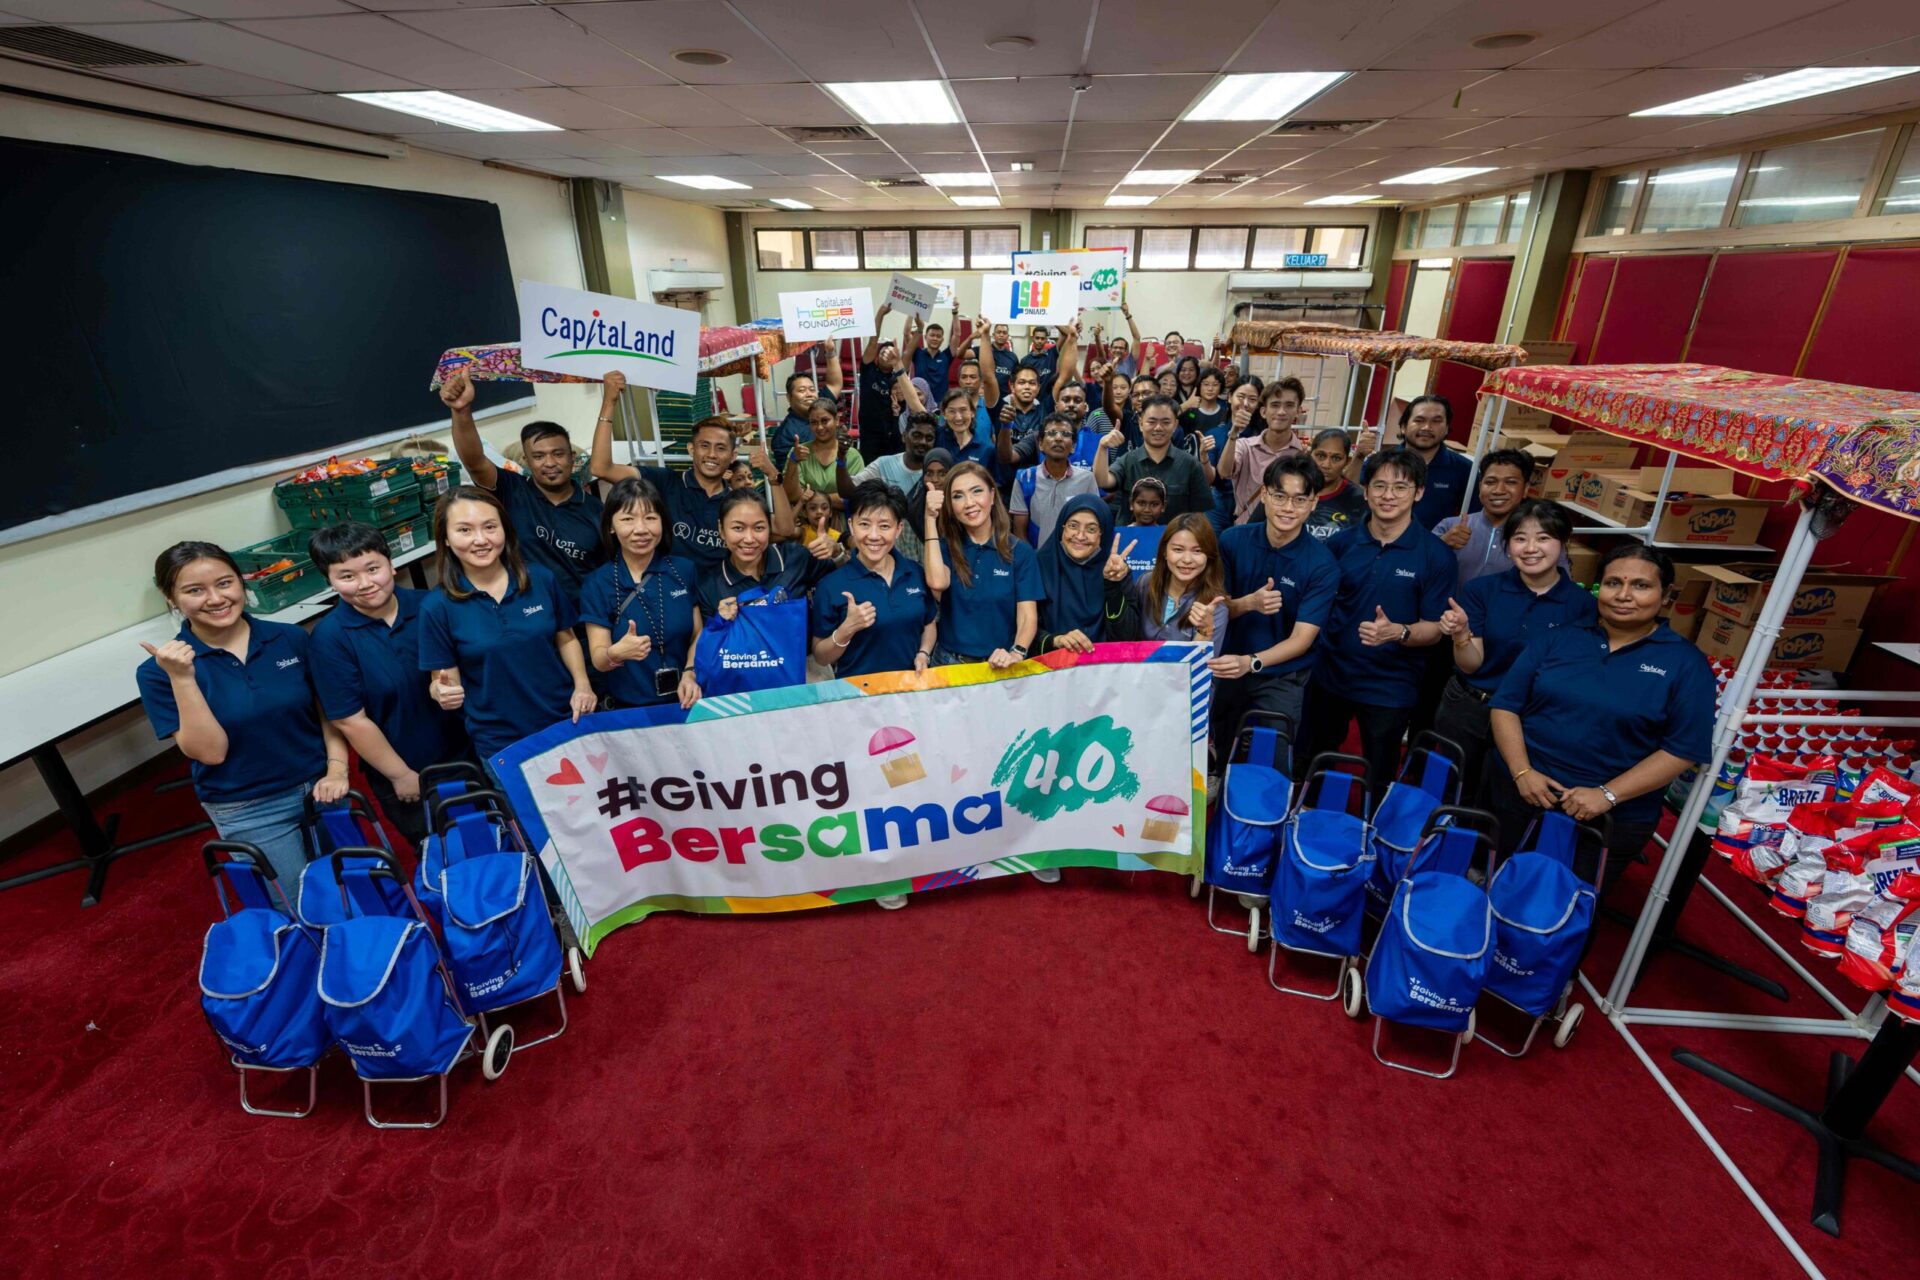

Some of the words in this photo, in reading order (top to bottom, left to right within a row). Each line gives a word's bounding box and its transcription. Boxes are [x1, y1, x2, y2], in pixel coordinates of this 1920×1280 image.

[1285, 255, 1319, 266] KELUAR
[1096, 272, 1114, 285] 4.0
[893, 284, 916, 300] #Giving
[815, 296, 853, 308] CapitaLand
[891, 290, 928, 309] Bersama
[796, 307, 853, 320] hope
[798, 317, 856, 329] FOUNDATION
[541, 307, 675, 357] CapitaLand
[698, 528, 720, 537] ASCO
[723, 653, 758, 661] #Giving
[723, 660, 778, 669] Bersama
[1024, 739, 1116, 796] 4.0
[596, 760, 850, 819] #Giving
[608, 790, 1004, 873] Bersama
[1410, 990, 1464, 1013] Bersama
